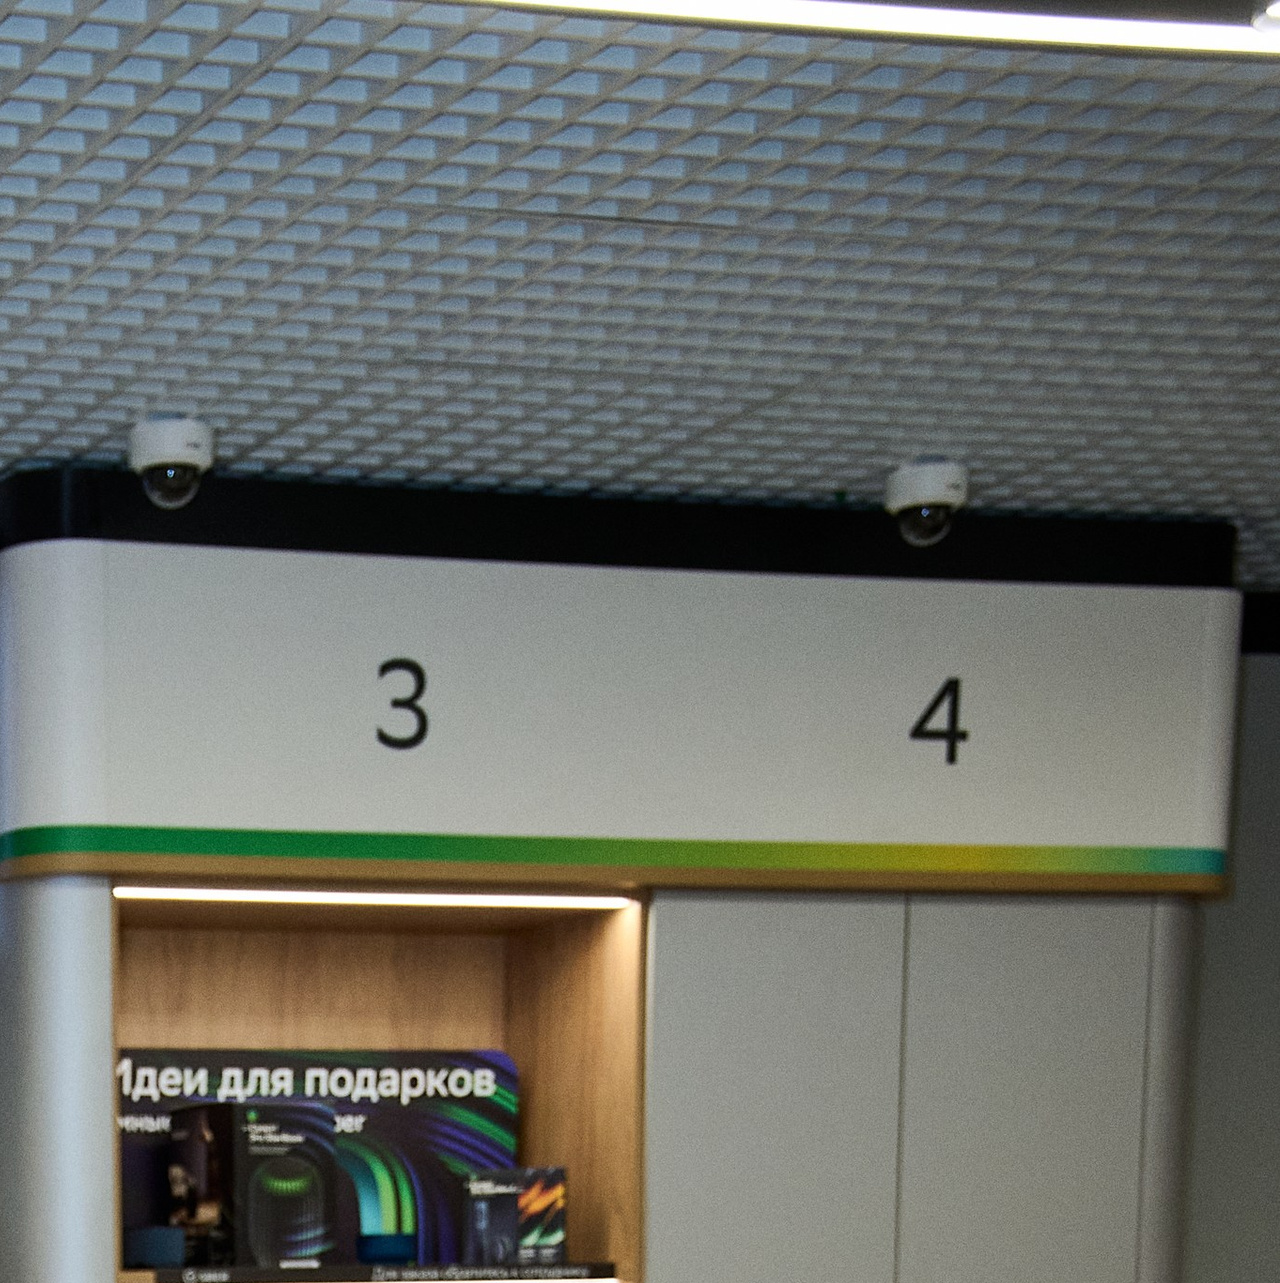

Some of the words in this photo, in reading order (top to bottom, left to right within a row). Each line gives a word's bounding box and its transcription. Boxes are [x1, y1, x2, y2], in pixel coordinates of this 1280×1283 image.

[376, 657, 429, 750] 3
[908, 676, 969, 765] 4
[217, 1065, 294, 1103] для
[304, 1066, 497, 1106] подарков
